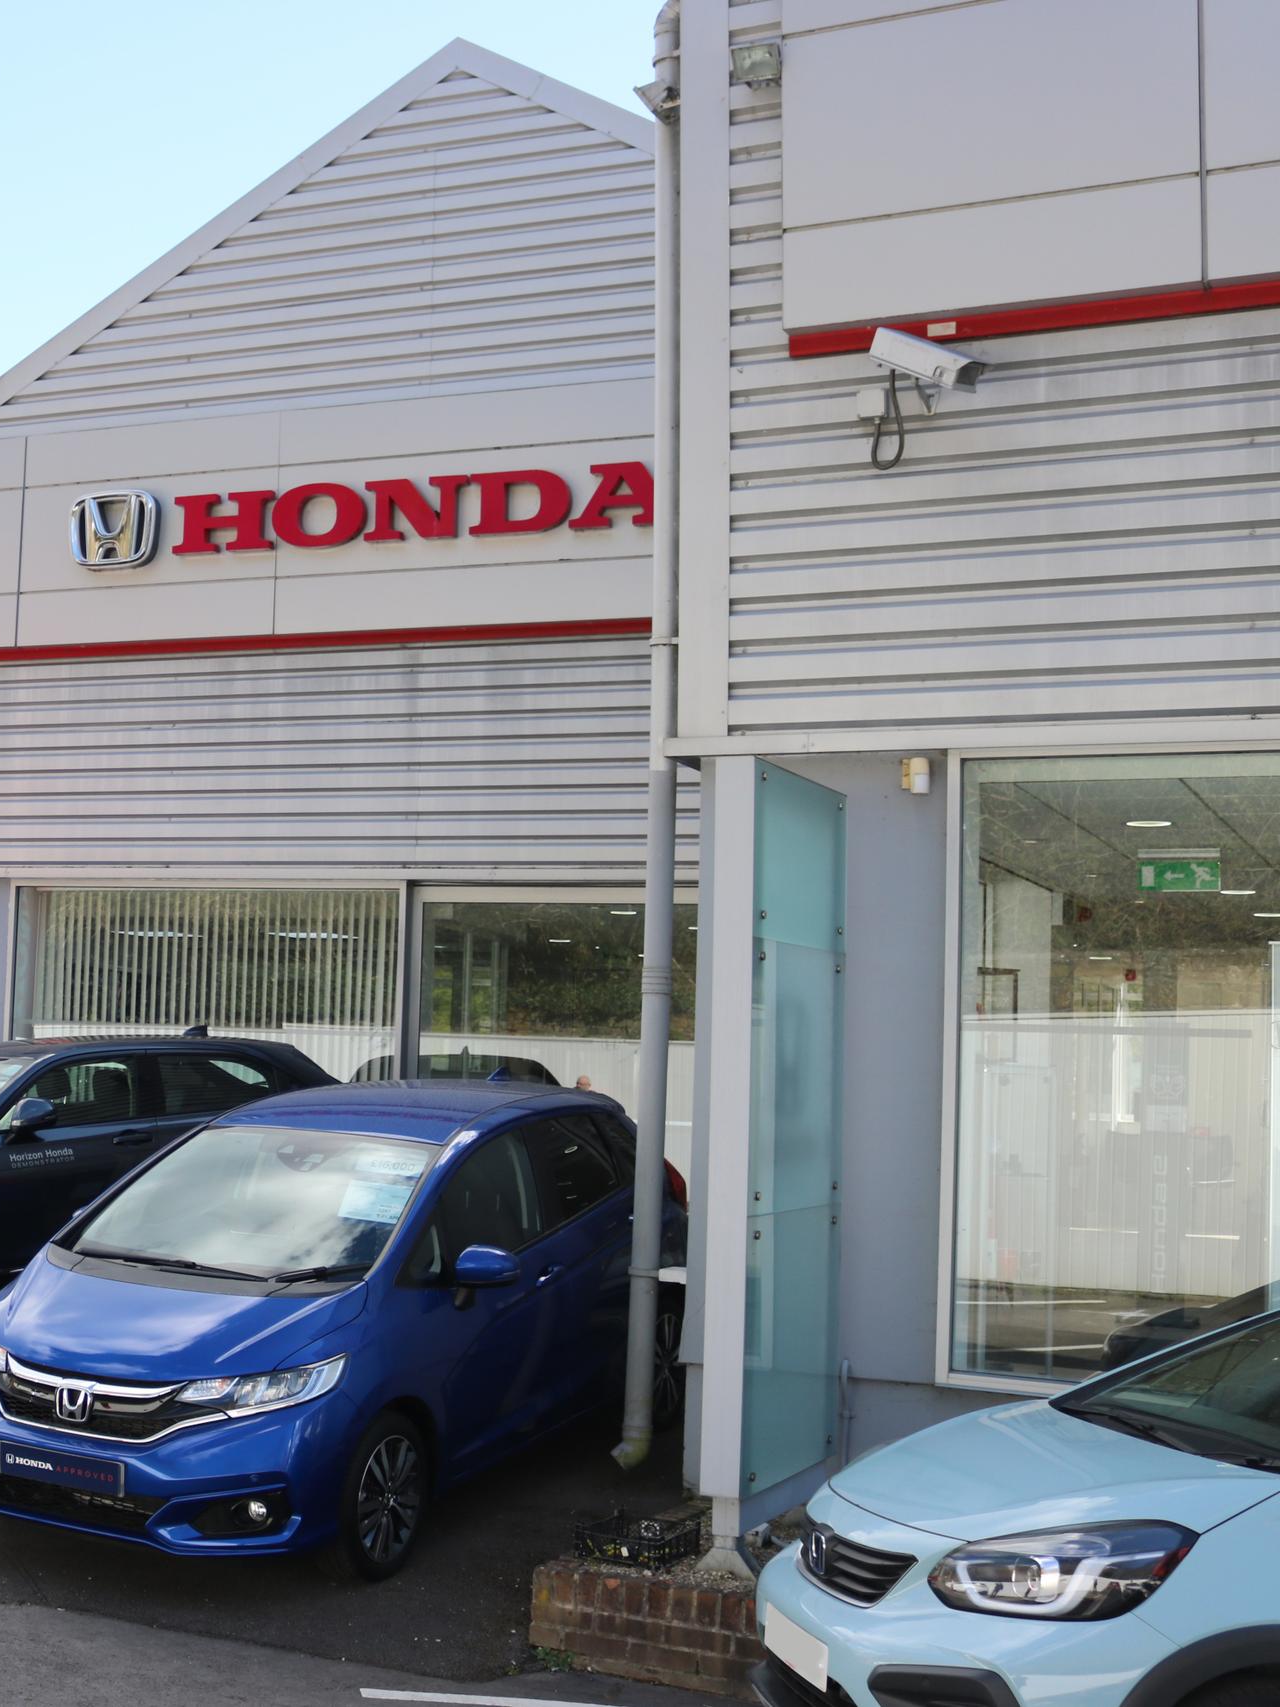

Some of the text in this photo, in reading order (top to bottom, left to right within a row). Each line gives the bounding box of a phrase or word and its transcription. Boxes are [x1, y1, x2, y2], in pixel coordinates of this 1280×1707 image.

[171, 461, 653, 556] HONDA
[9, 1147, 74, 1162] Horizon Honda
[11, 1156, 75, 1169] DEMONSTRATOR
[15, 1456, 114, 1482] HONDA APPROVED
